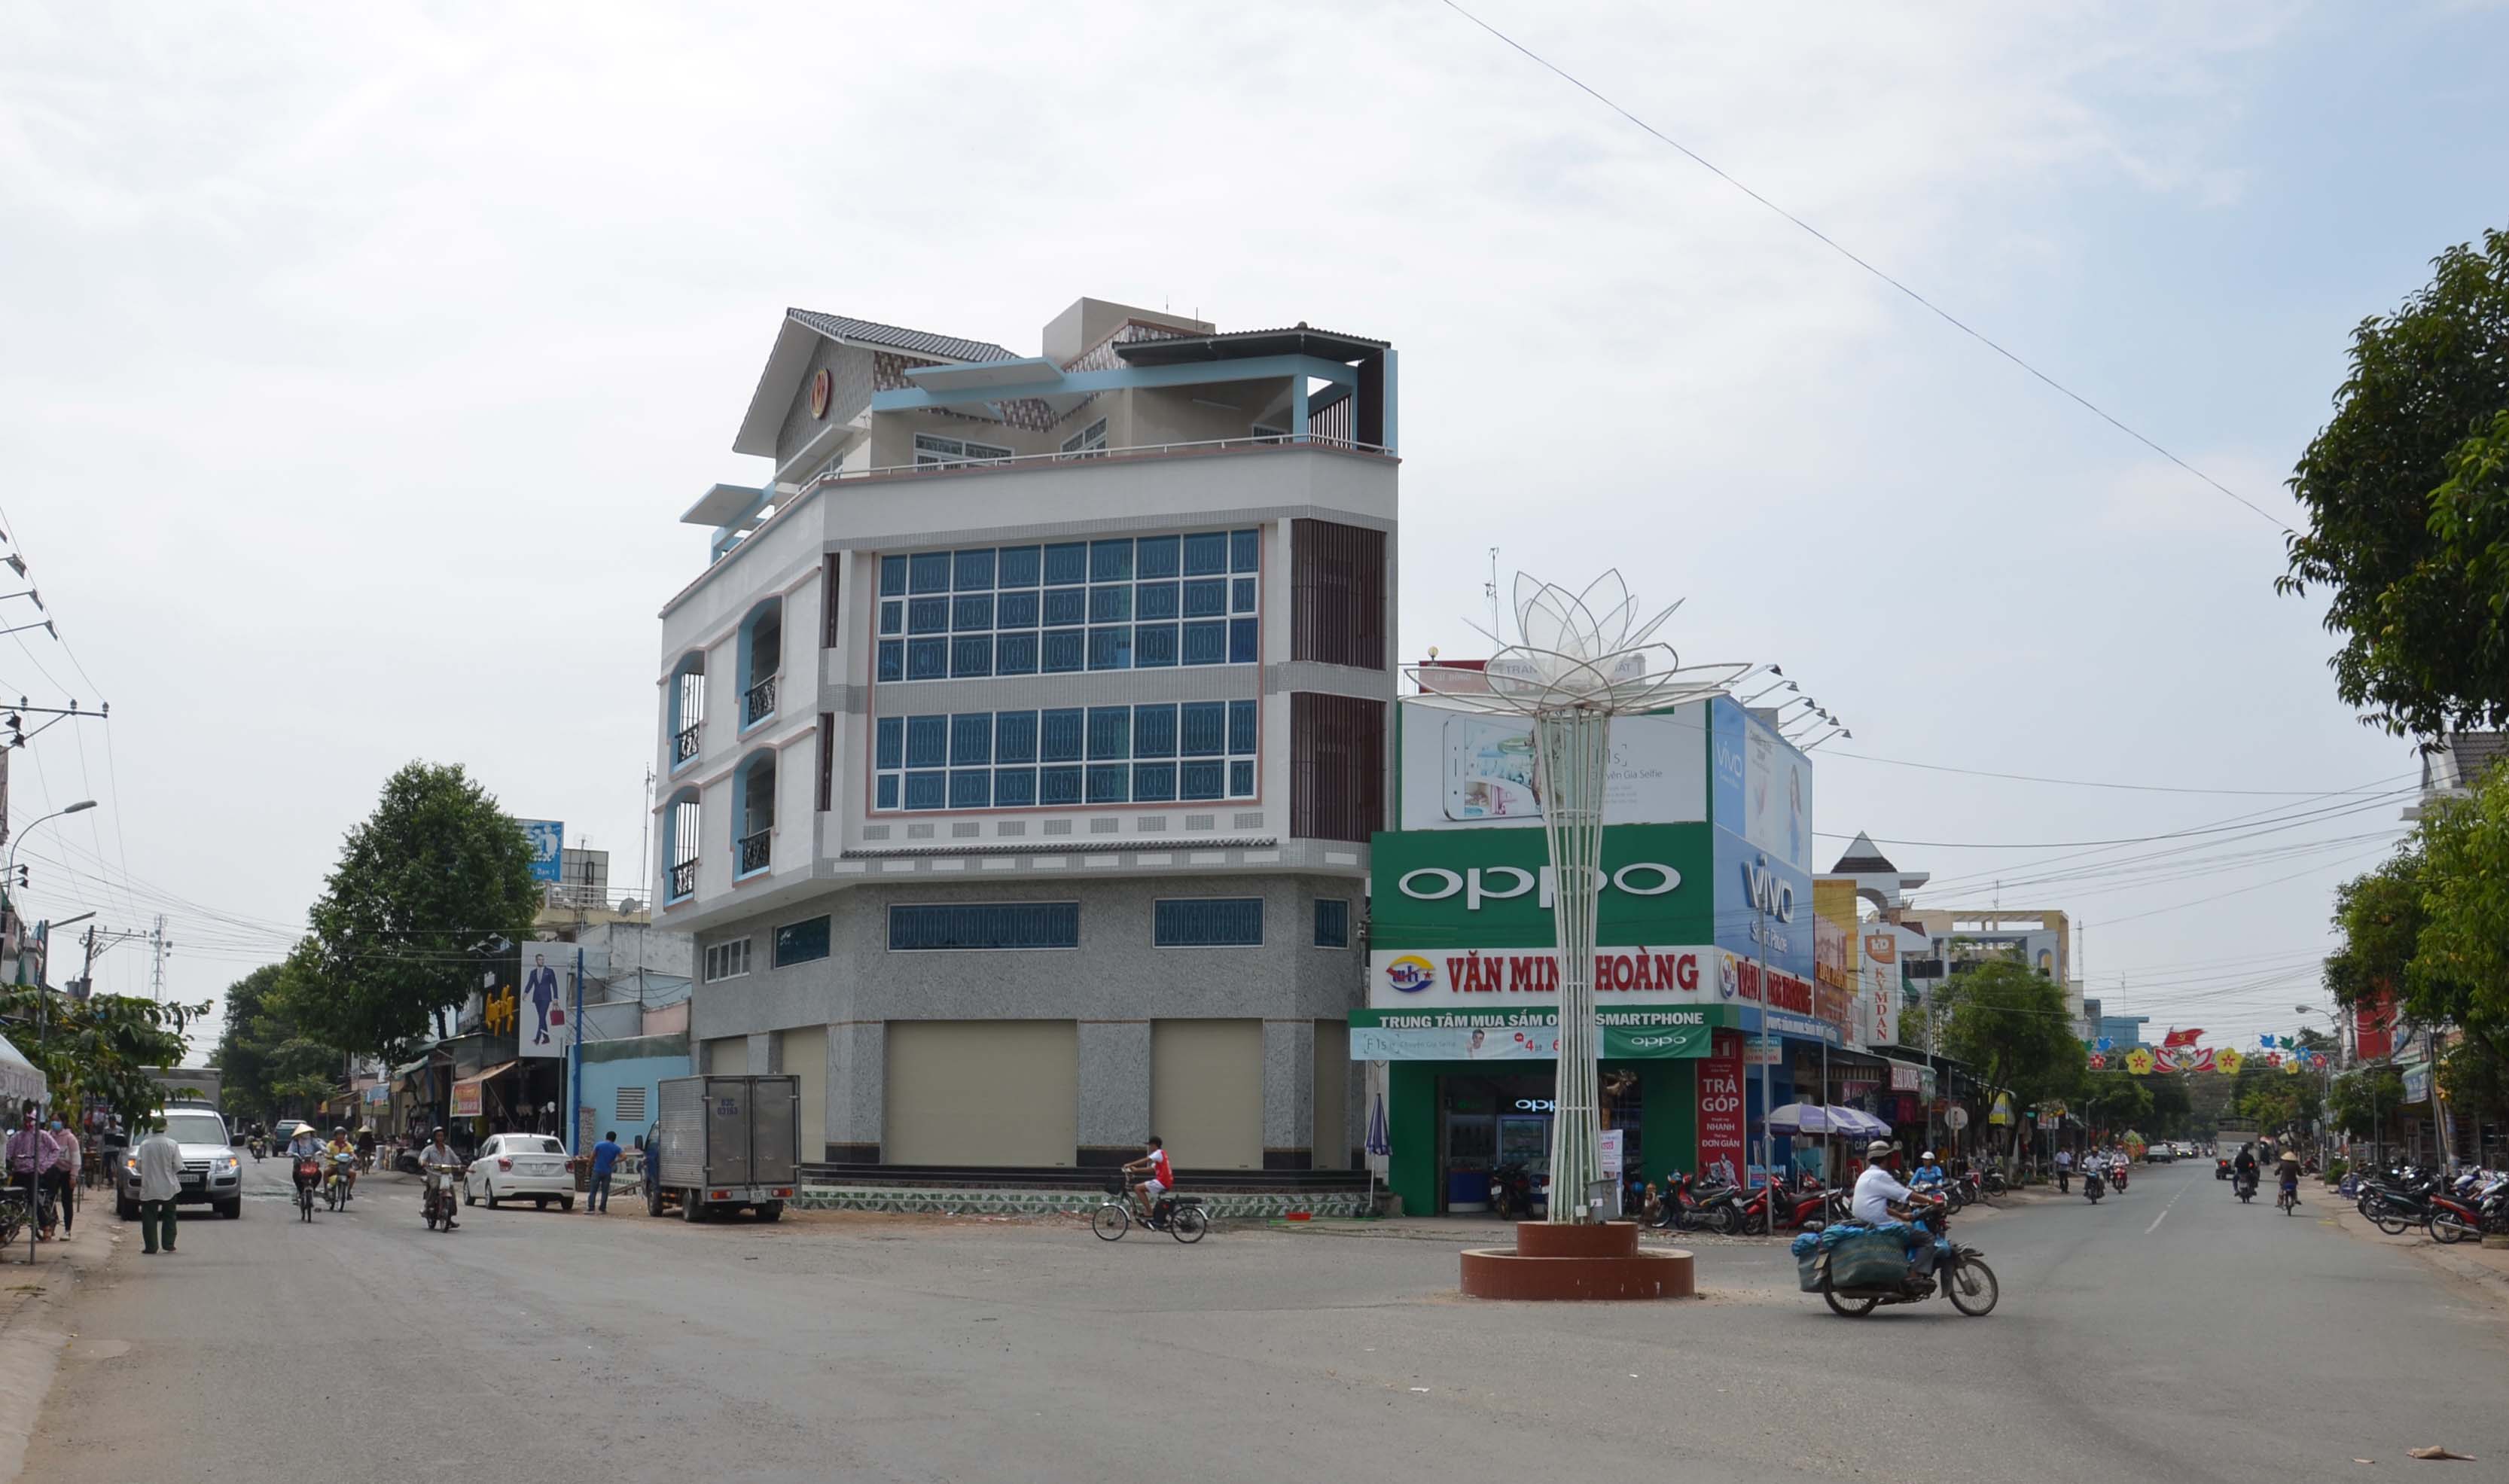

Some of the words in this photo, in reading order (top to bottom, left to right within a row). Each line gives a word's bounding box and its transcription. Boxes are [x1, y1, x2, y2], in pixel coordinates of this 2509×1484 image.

[1716, 741, 1742, 778] vivo
[1623, 769, 1638, 779] Gia
[1639, 768, 1663, 779] Selfie
[1741, 853, 1794, 924] vivo
[1447, 949, 1503, 992] VĂN
[1510, 956, 1559, 992] MIN
[1595, 946, 1700, 991] HOÀNG
[1874, 967, 1889, 1041] KYMDAN
[1379, 1016, 1431, 1029] TRUNG
[1435, 1012, 1468, 1028] TÂM
[1471, 1015, 1505, 1028] MUA
[1508, 1008, 1543, 1027] SẮM
[1594, 1012, 1705, 1026] SMARTPHONE
[1631, 1036, 1687, 1047] oppo
[1703, 1074, 1737, 1092] TRẢ
[1515, 1099, 1556, 1112] op
[1702, 1095, 1739, 1112] GÓP
[1706, 1123, 1736, 1131] NHANH
[1702, 1139, 1720, 1147] ĐƠN
[1721, 1138, 1740, 1147] GIẢN
